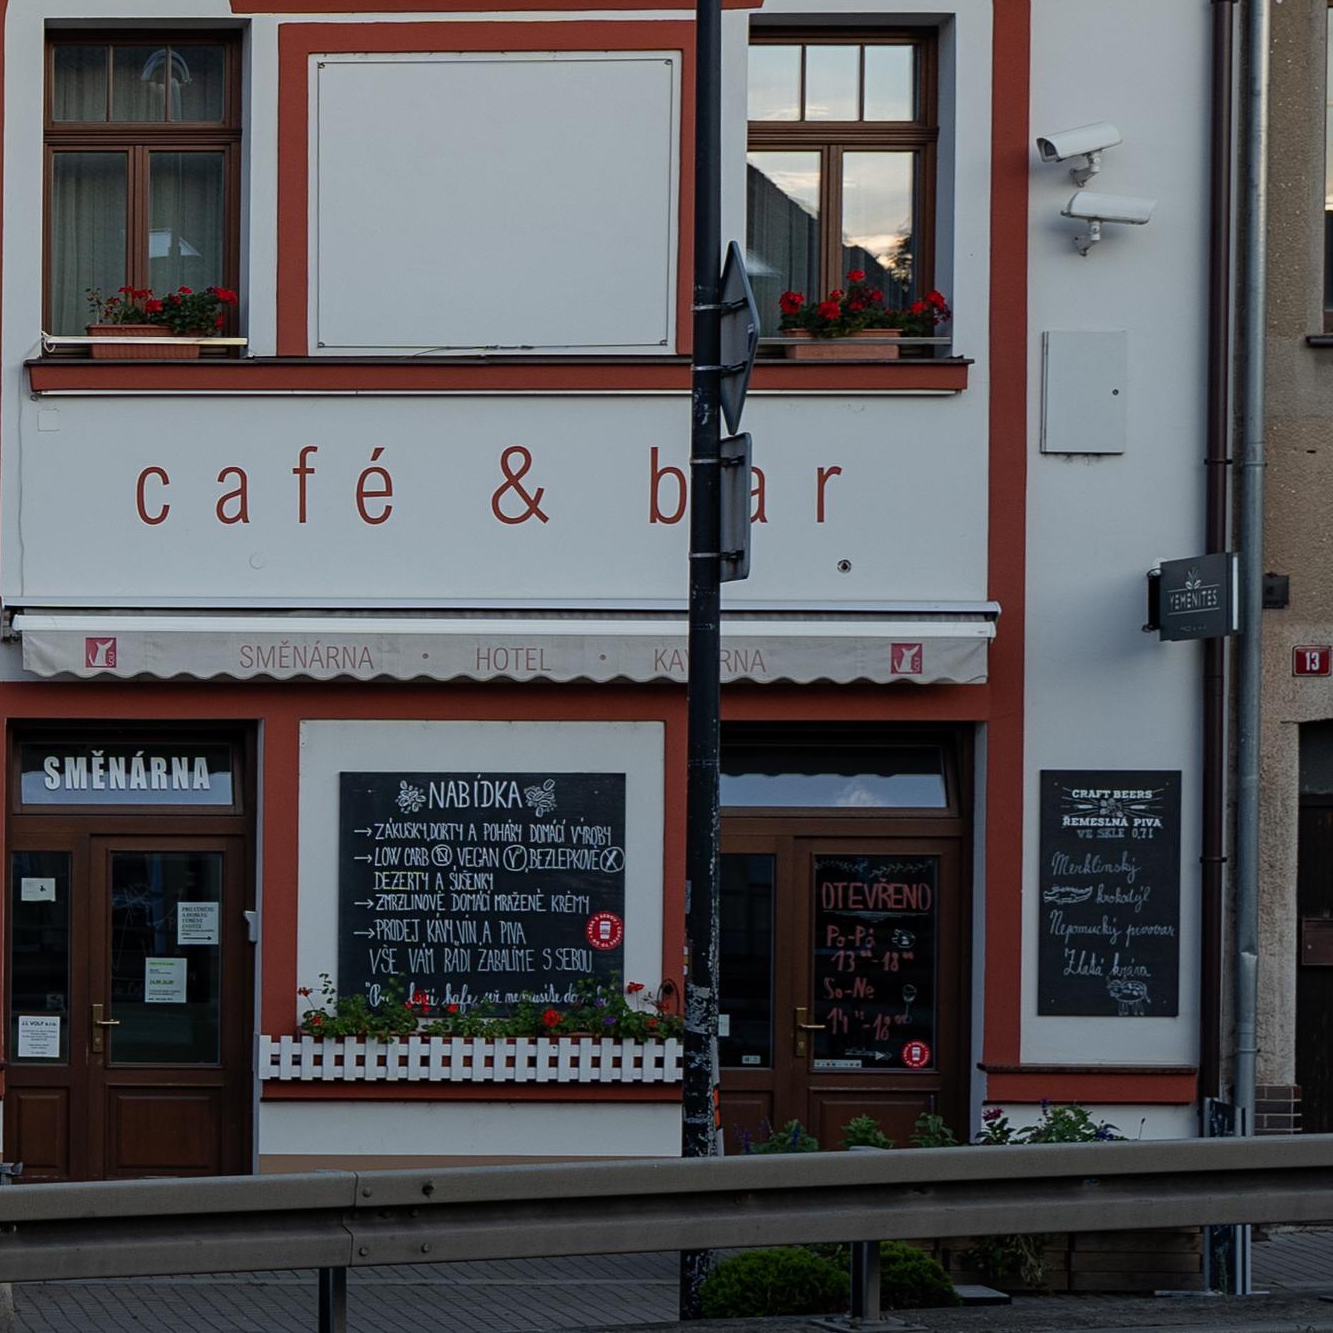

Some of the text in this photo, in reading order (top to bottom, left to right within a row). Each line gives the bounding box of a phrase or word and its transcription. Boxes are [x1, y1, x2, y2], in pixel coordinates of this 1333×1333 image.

[136, 445, 393, 525] café
[490, 445, 550, 525] &
[1169, 588, 1218, 611] YEMENITES
[239, 640, 375, 670] SMĚNÁRNA
[475, 646, 552, 672] HOTEL
[1304, 651, 1321, 671] 13
[43, 749, 211, 790] SMĚNÁRNA
[428, 773, 524, 810] NABÍDKA
[1071, 789, 1154, 800] CRAFT BEERS
[467, 822, 478, 841] A
[483, 819, 523, 843] POHÁRY
[528, 818, 567, 844] DOMÁCÍ
[570, 817, 613, 847] VÝROBY
[1062, 814, 1163, 828] ŘEMESLNÁ PIVA
[1076, 828, 1094, 839] VE
[1096, 828, 1125, 839] SKLE
[374, 846, 402, 867] LOW
[404, 846, 430, 867] CARB
[373, 871, 430, 892] DEZERTY
[435, 871, 445, 891] A
[821, 877, 933, 912] OTEVŘENO
[375, 888, 591, 915] ZMRZLINOVÉ DOMÁCÍ MRAŽENÉ KRÉMY
[373, 919, 422, 943] PRODEJ
[499, 920, 528, 945] PIVA
[369, 944, 400, 974] VŠE
[408, 942, 436, 975] VÁM
[476, 945, 535, 973] ZABALÍME
[542, 947, 554, 971] S
[554, 947, 594, 973] SEBOU
